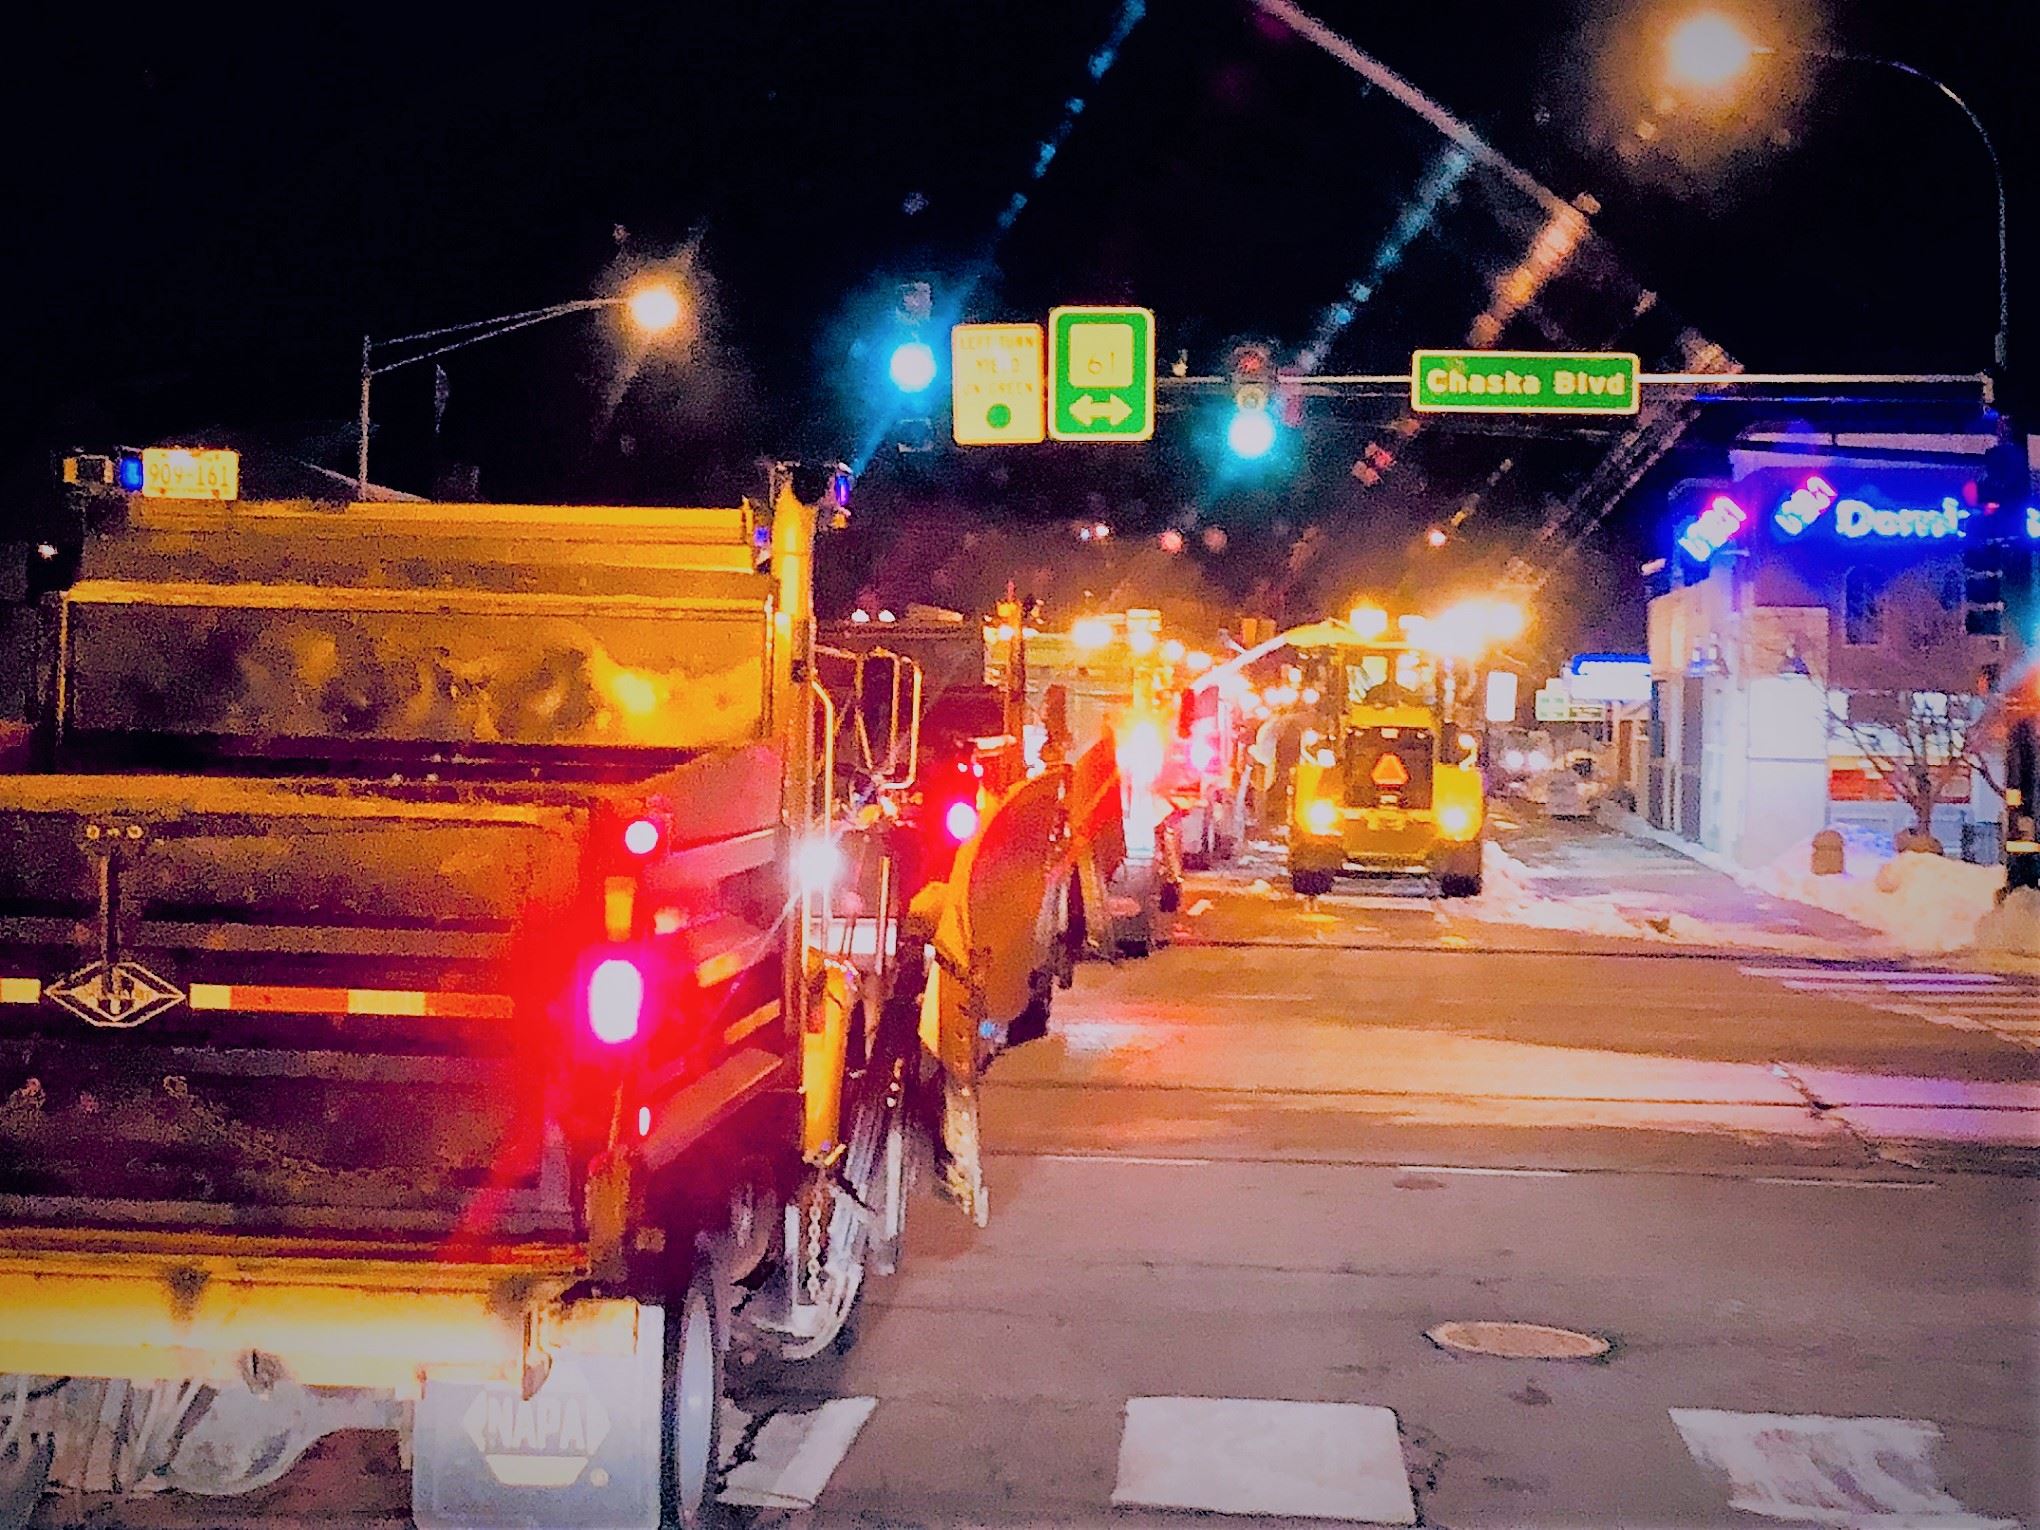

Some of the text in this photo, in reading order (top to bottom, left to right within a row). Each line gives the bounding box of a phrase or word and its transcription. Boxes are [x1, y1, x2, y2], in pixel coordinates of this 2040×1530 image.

[1427, 368, 1626, 396] Chaska Blvd
[487, 1395, 588, 1451] NAPA
